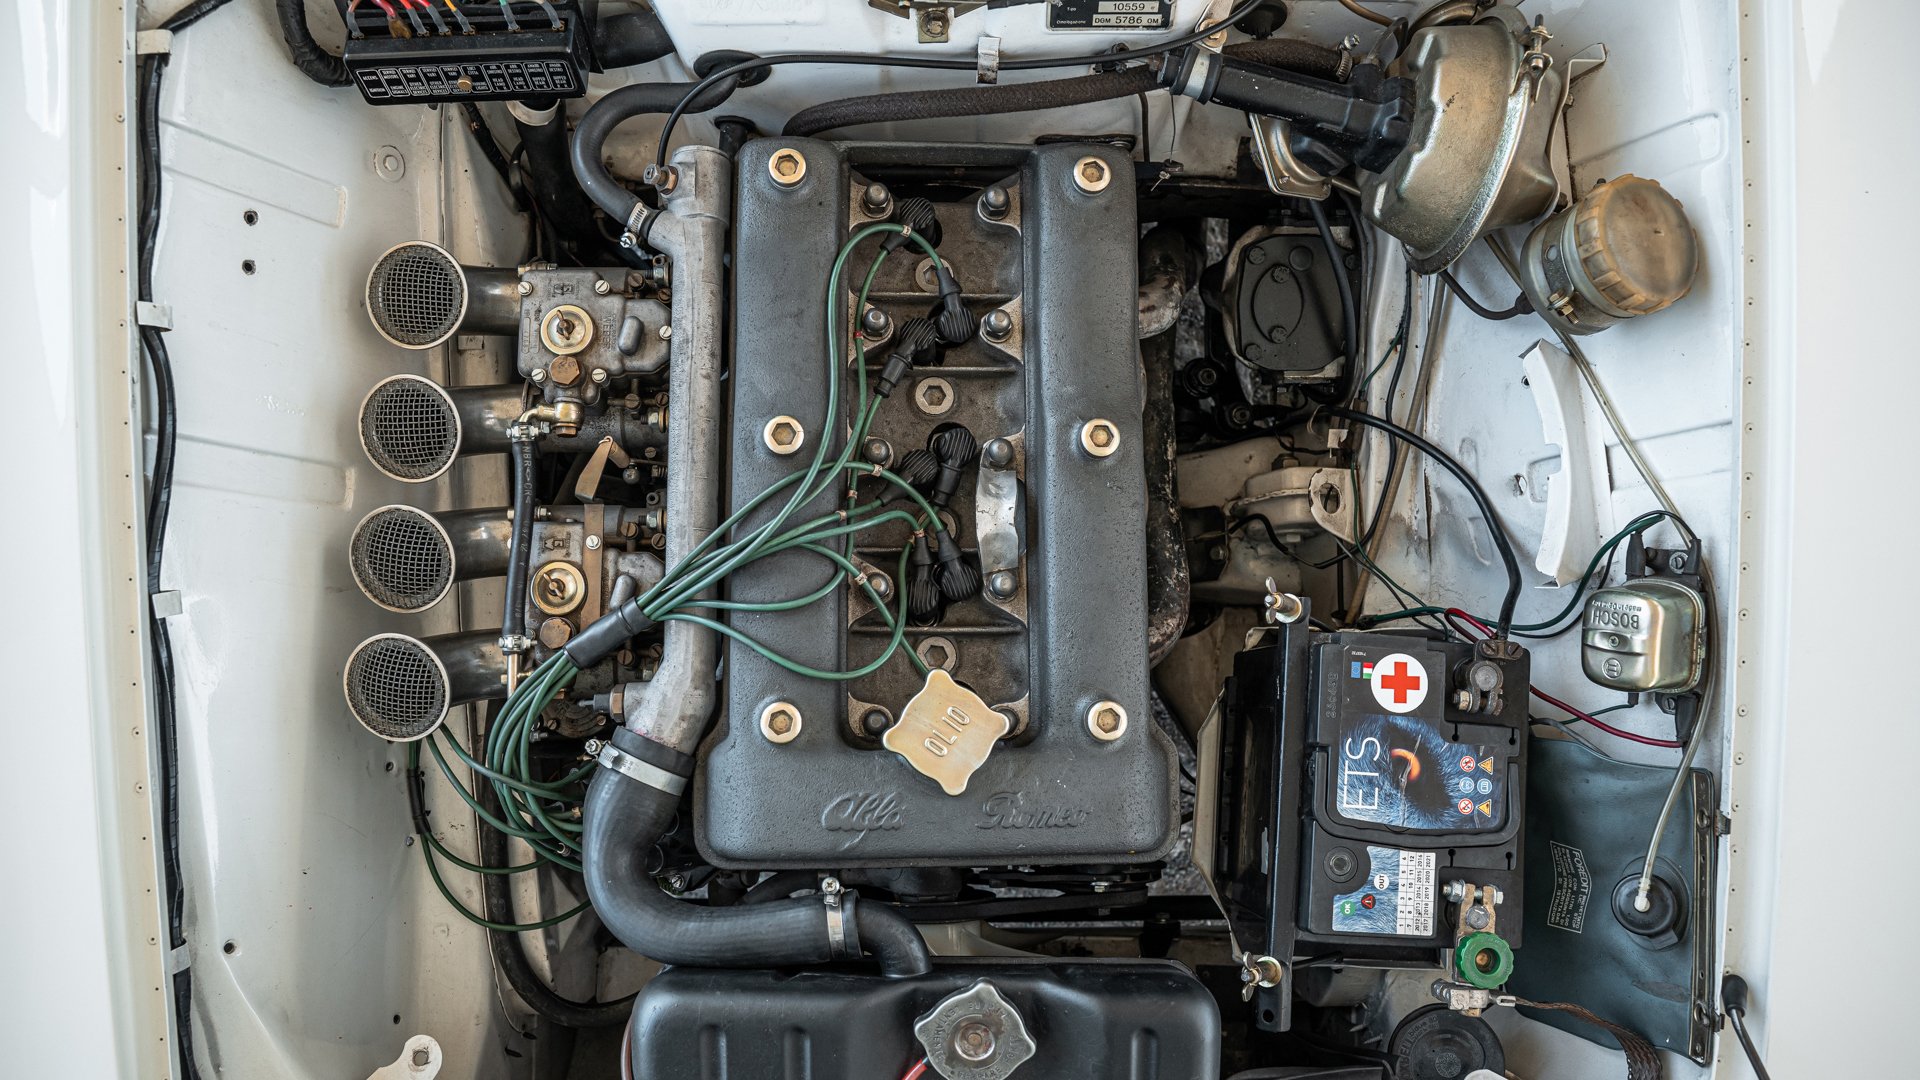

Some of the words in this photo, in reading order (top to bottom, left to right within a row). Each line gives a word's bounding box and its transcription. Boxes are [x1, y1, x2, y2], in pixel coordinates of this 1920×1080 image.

[1113, 2, 1146, 12] 10559
[1115, 15, 1143, 25] 5786
[1591, 608, 1640, 629] BOSCH
[924, 705, 970, 757] OLIO
[1343, 737, 1380, 809] ETS
[821, 792, 906, 851] Alfa
[975, 791, 1093, 830] Romeo
[1572, 851, 1589, 894] FOREDIT
[1344, 903, 1351, 914] OK
